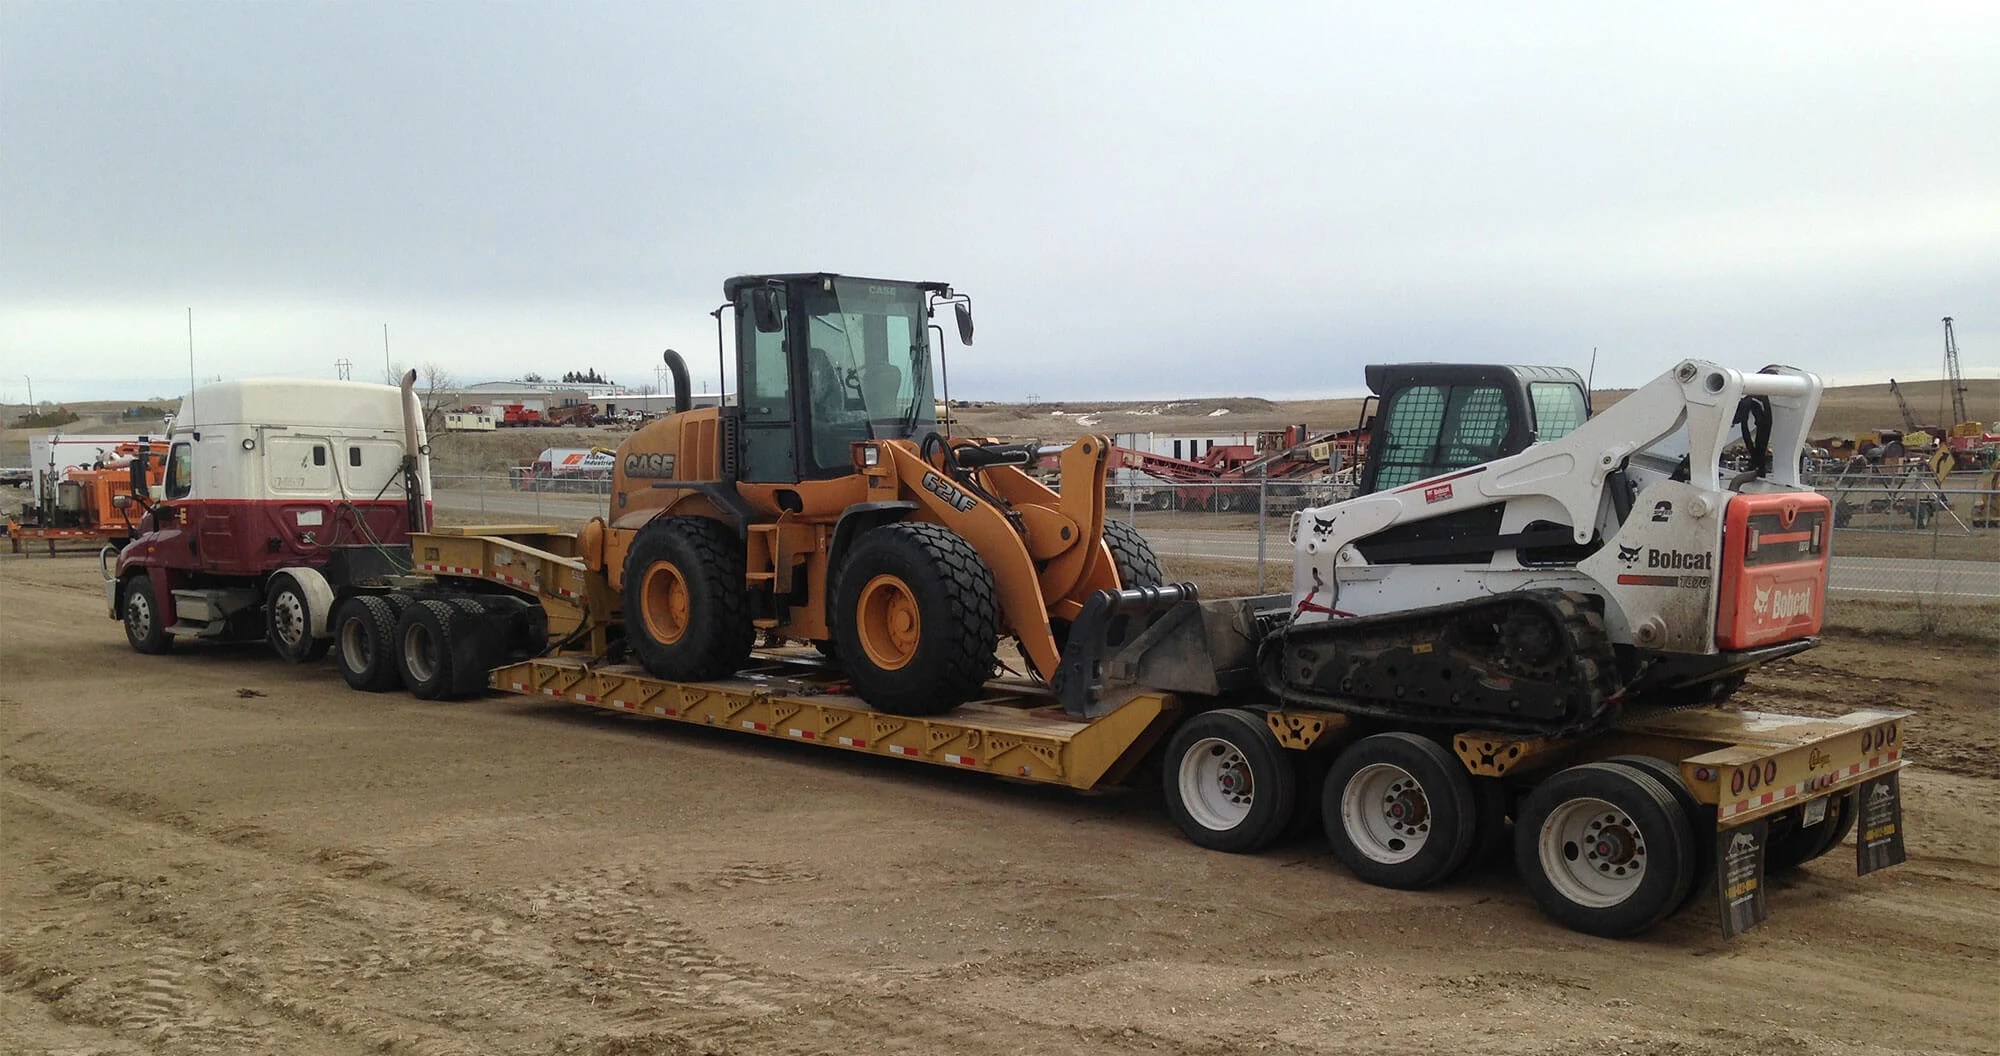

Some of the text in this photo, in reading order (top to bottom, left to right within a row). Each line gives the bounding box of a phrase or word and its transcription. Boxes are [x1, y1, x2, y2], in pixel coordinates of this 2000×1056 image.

[624, 453, 675, 478] CASE
[922, 471, 977, 512] 621F
[1648, 549, 1712, 570] Bobcat
[1772, 587, 1810, 619] Bobcat
